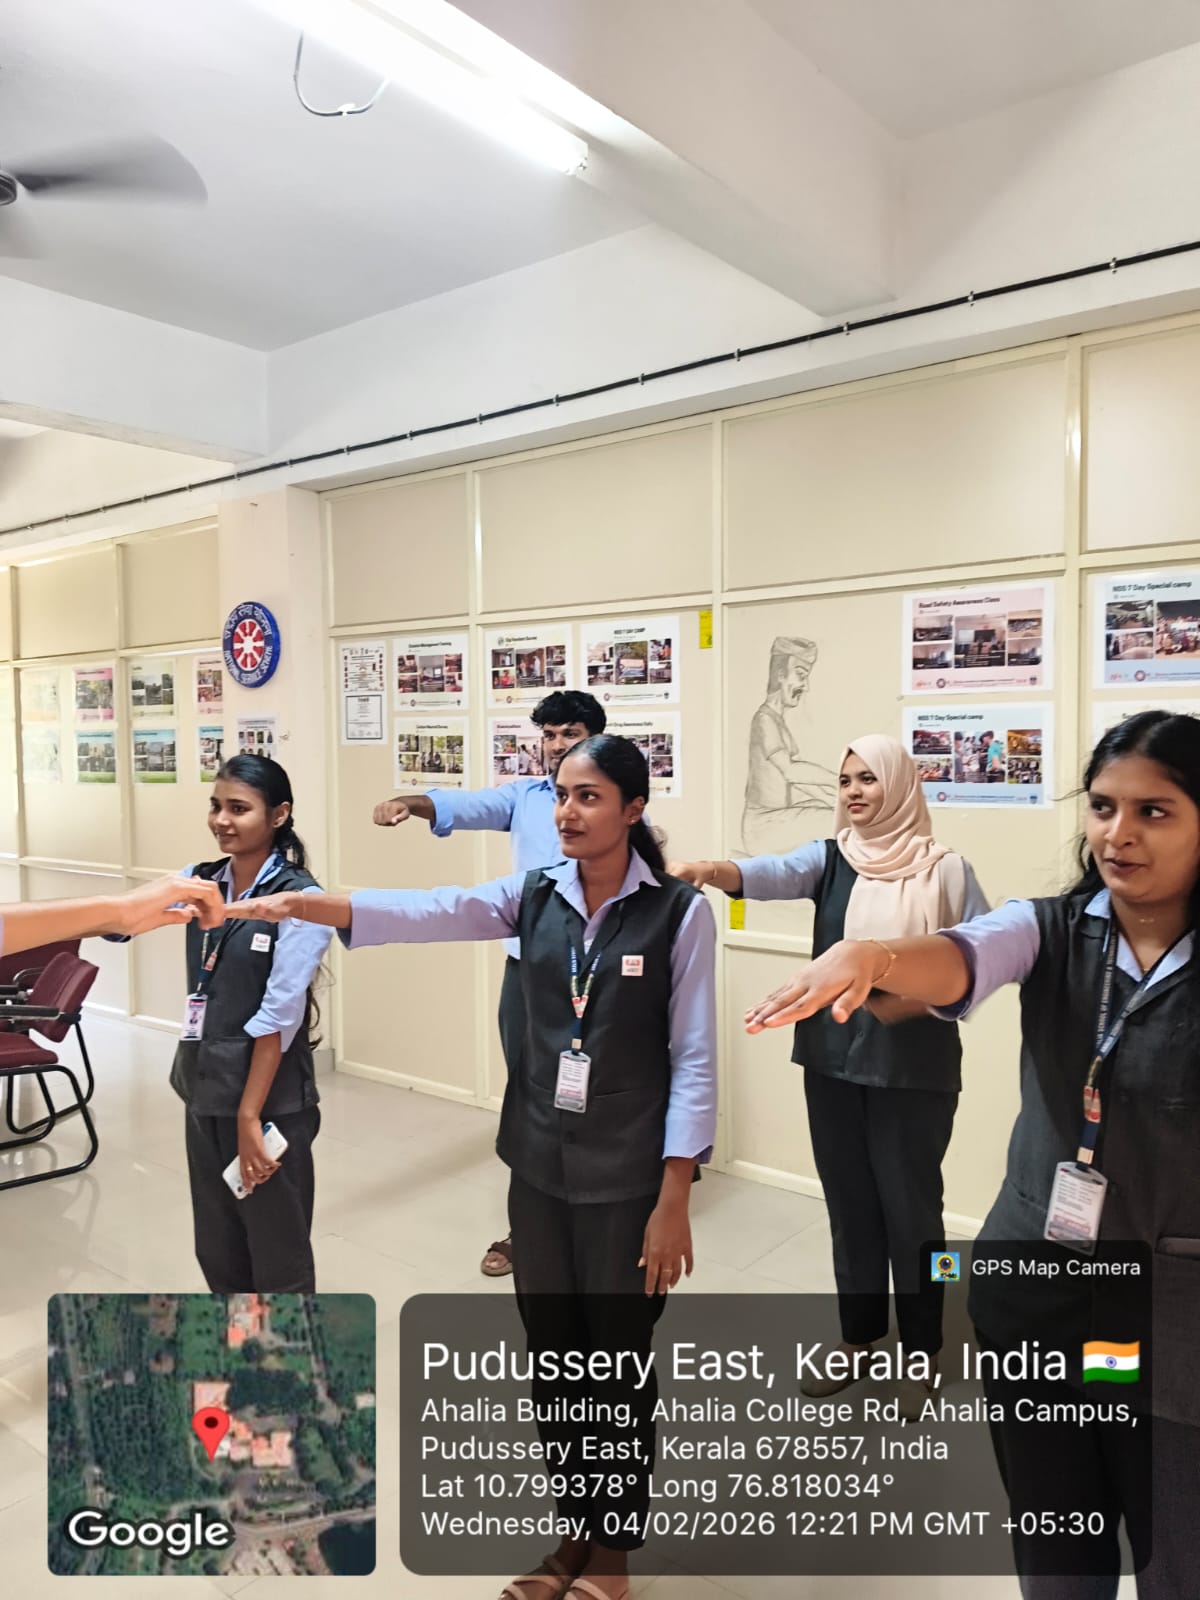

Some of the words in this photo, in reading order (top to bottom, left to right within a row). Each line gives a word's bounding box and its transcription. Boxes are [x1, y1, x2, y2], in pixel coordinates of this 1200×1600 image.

[1133, 584, 1146, 592] Day
[1147, 581, 1172, 590] Special
[1173, 581, 1192, 589] camp
